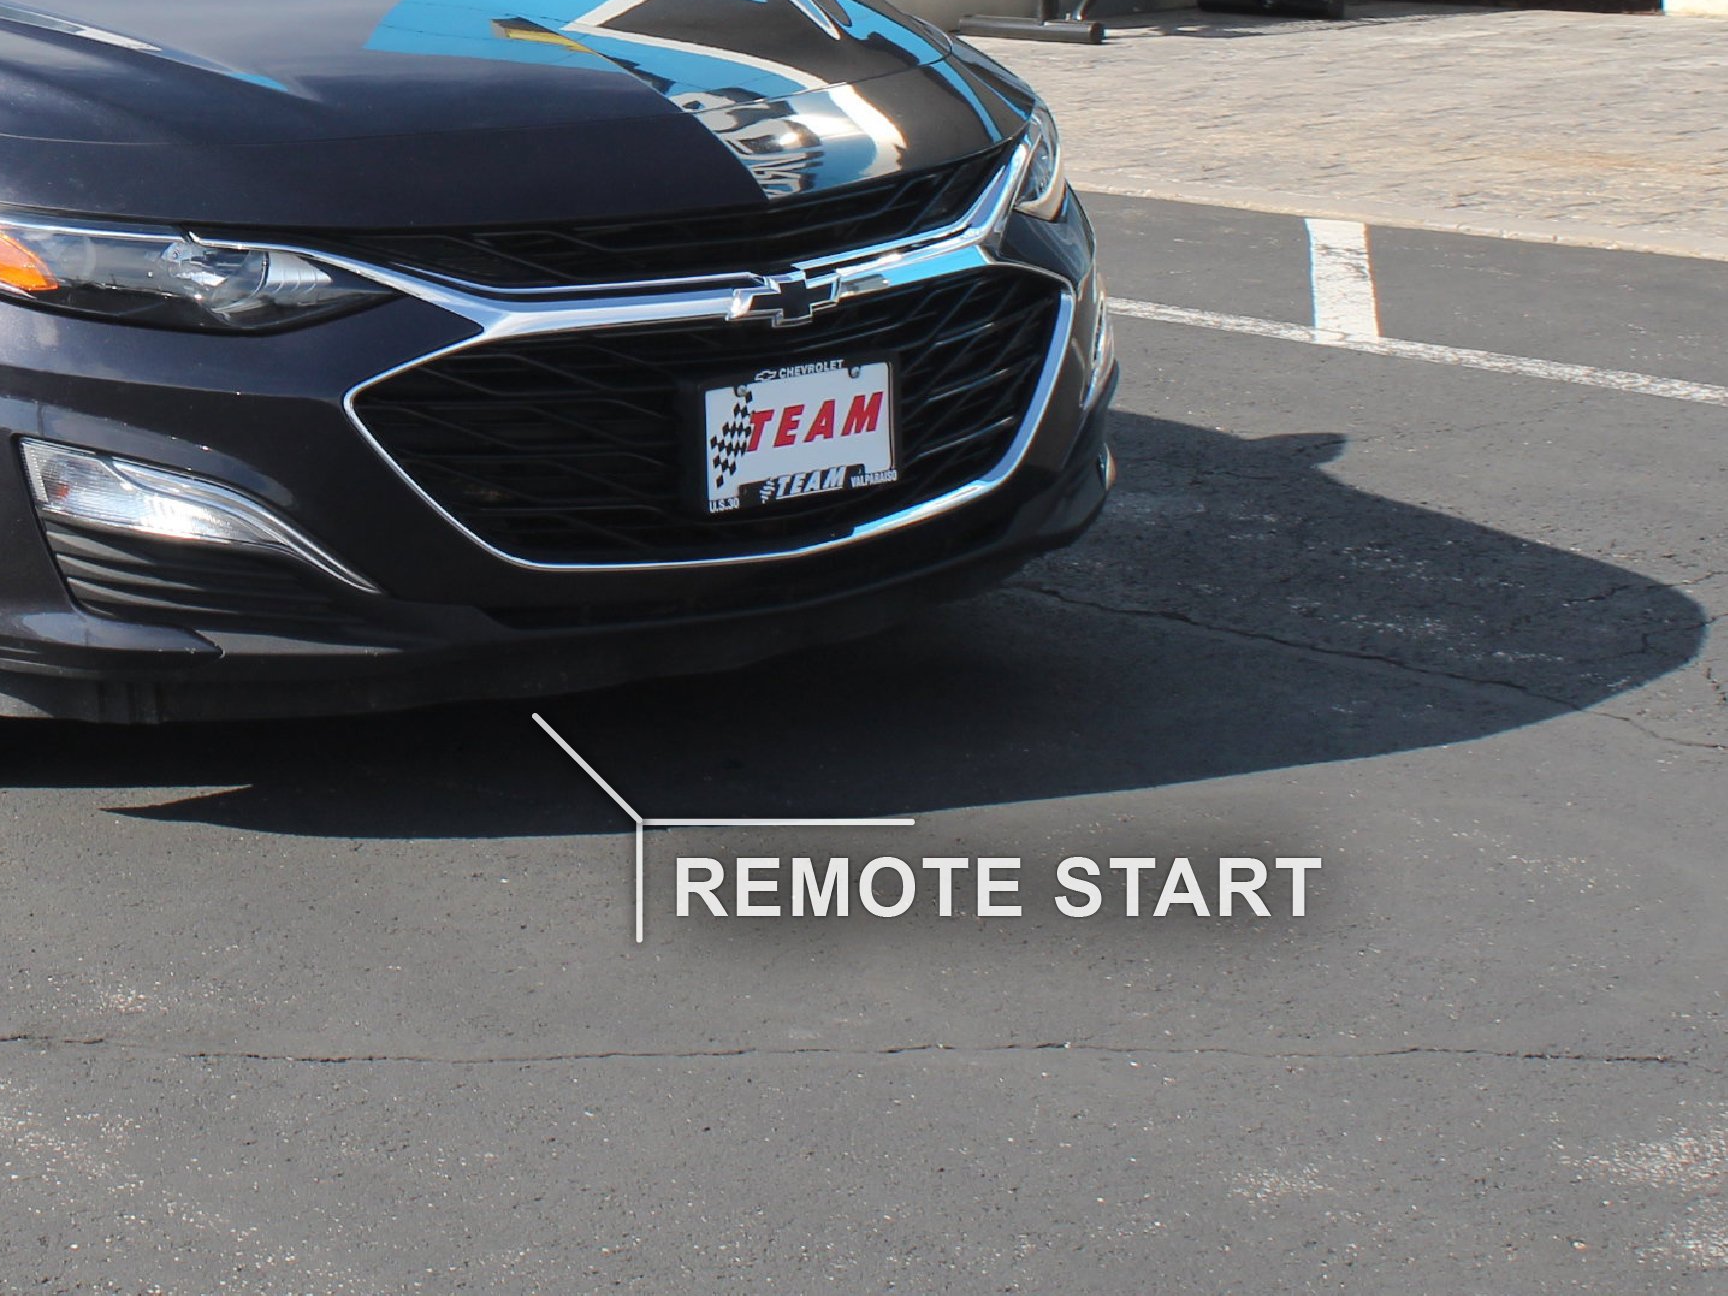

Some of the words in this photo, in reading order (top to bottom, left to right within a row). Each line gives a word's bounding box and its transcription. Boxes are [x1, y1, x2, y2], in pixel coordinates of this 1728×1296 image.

[779, 359, 844, 379] CHEVROLET
[746, 391, 884, 452] TEAM
[775, 466, 847, 499] TEAM
